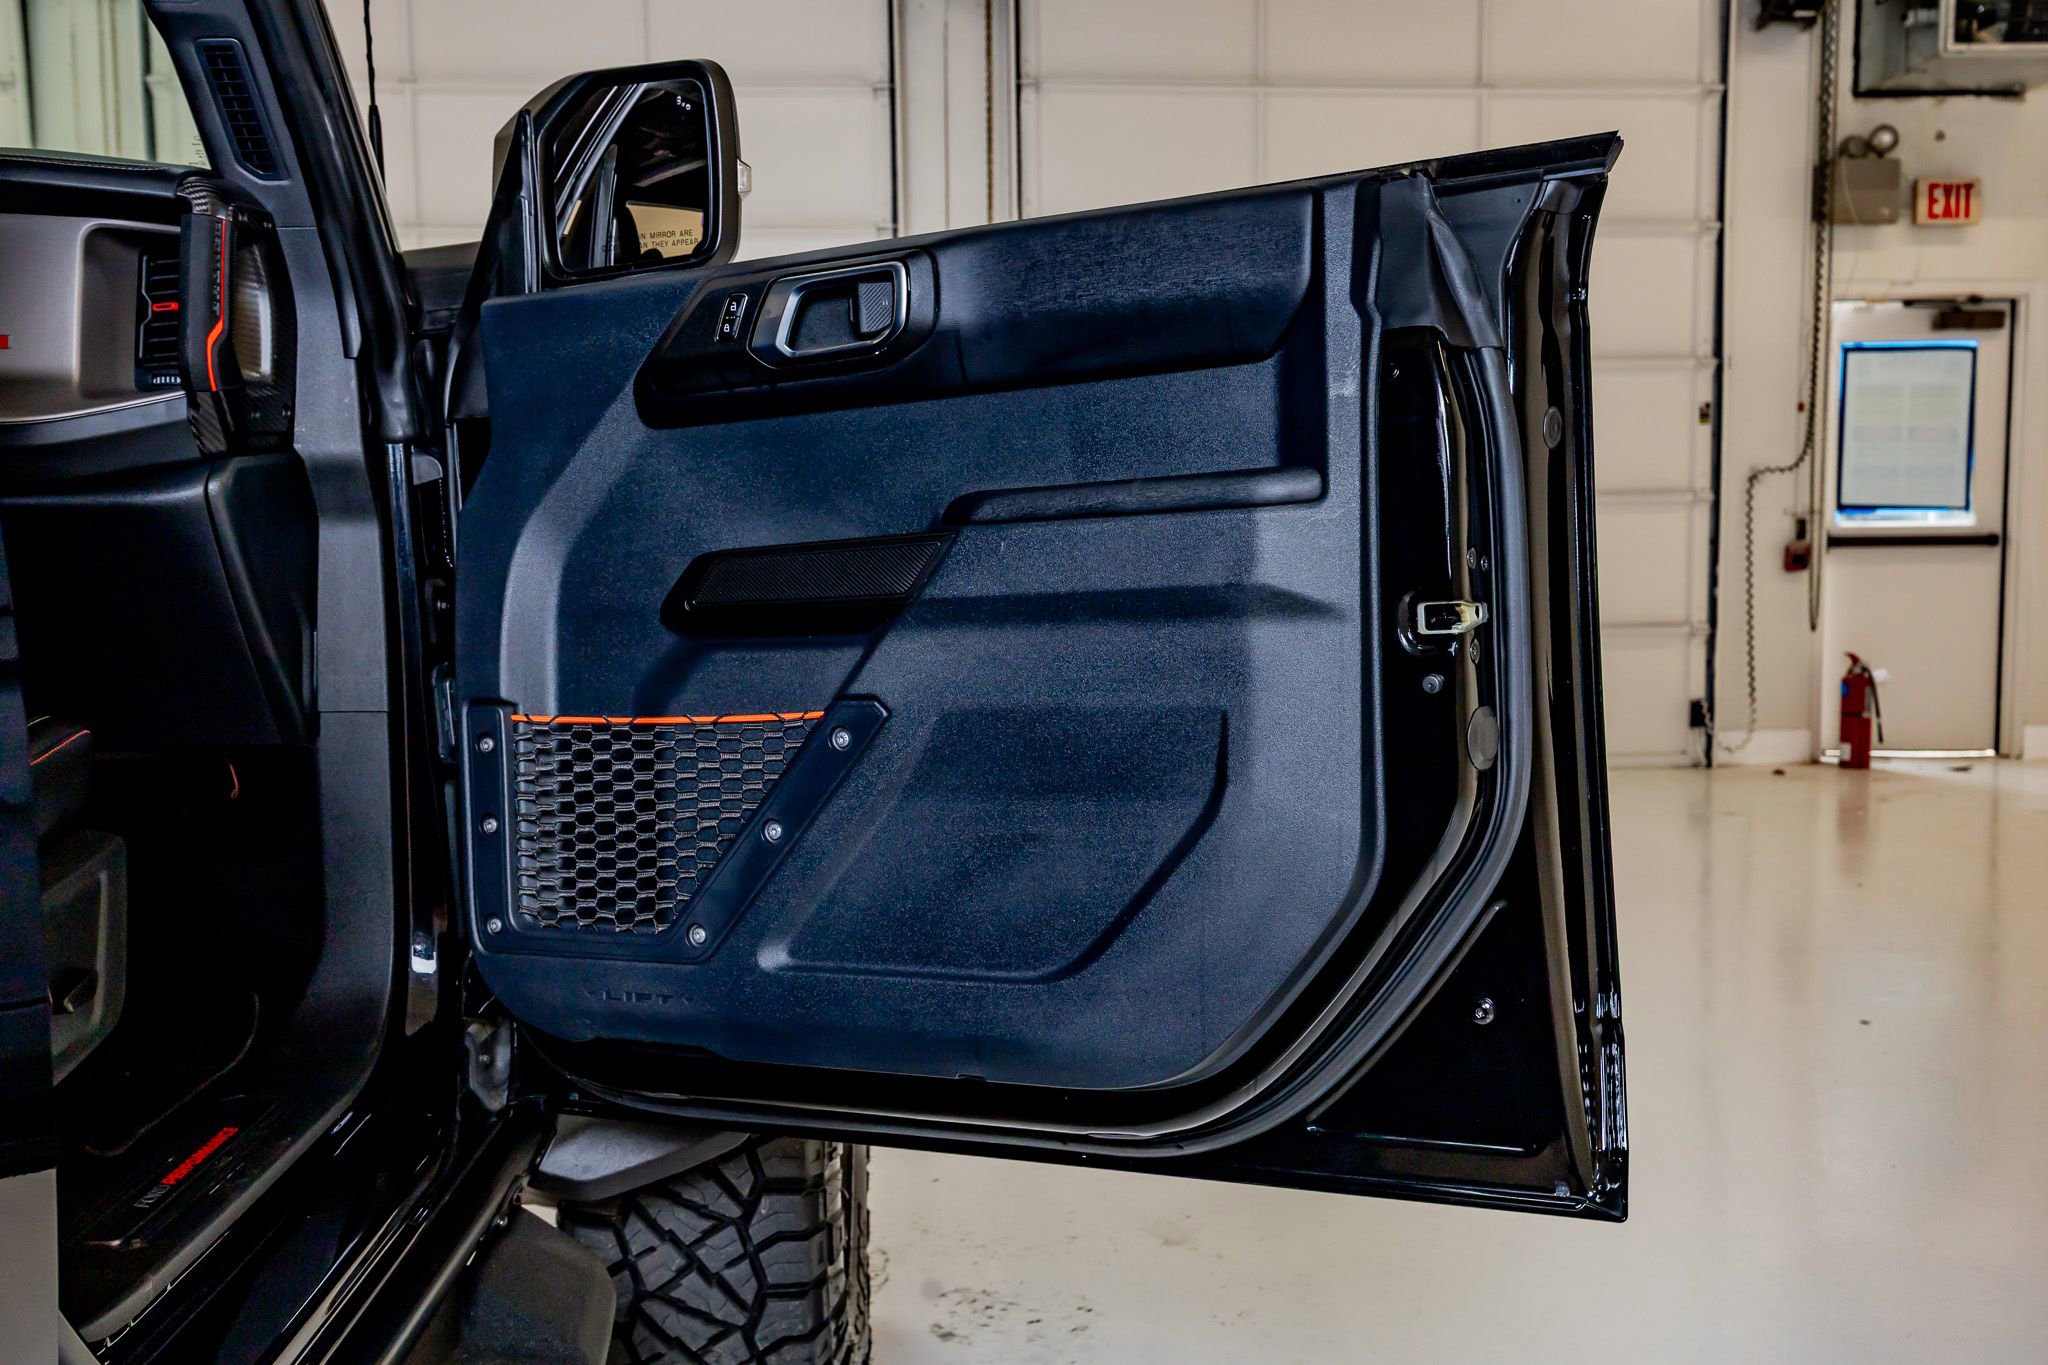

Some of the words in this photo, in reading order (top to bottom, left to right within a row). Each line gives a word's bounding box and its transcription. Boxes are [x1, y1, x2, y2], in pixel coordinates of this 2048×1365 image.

[1927, 182, 1975, 219] EXIT
[650, 230, 676, 239] MIRROR
[680, 229, 693, 237] ARE
[672, 238, 699, 246] APPEAR
